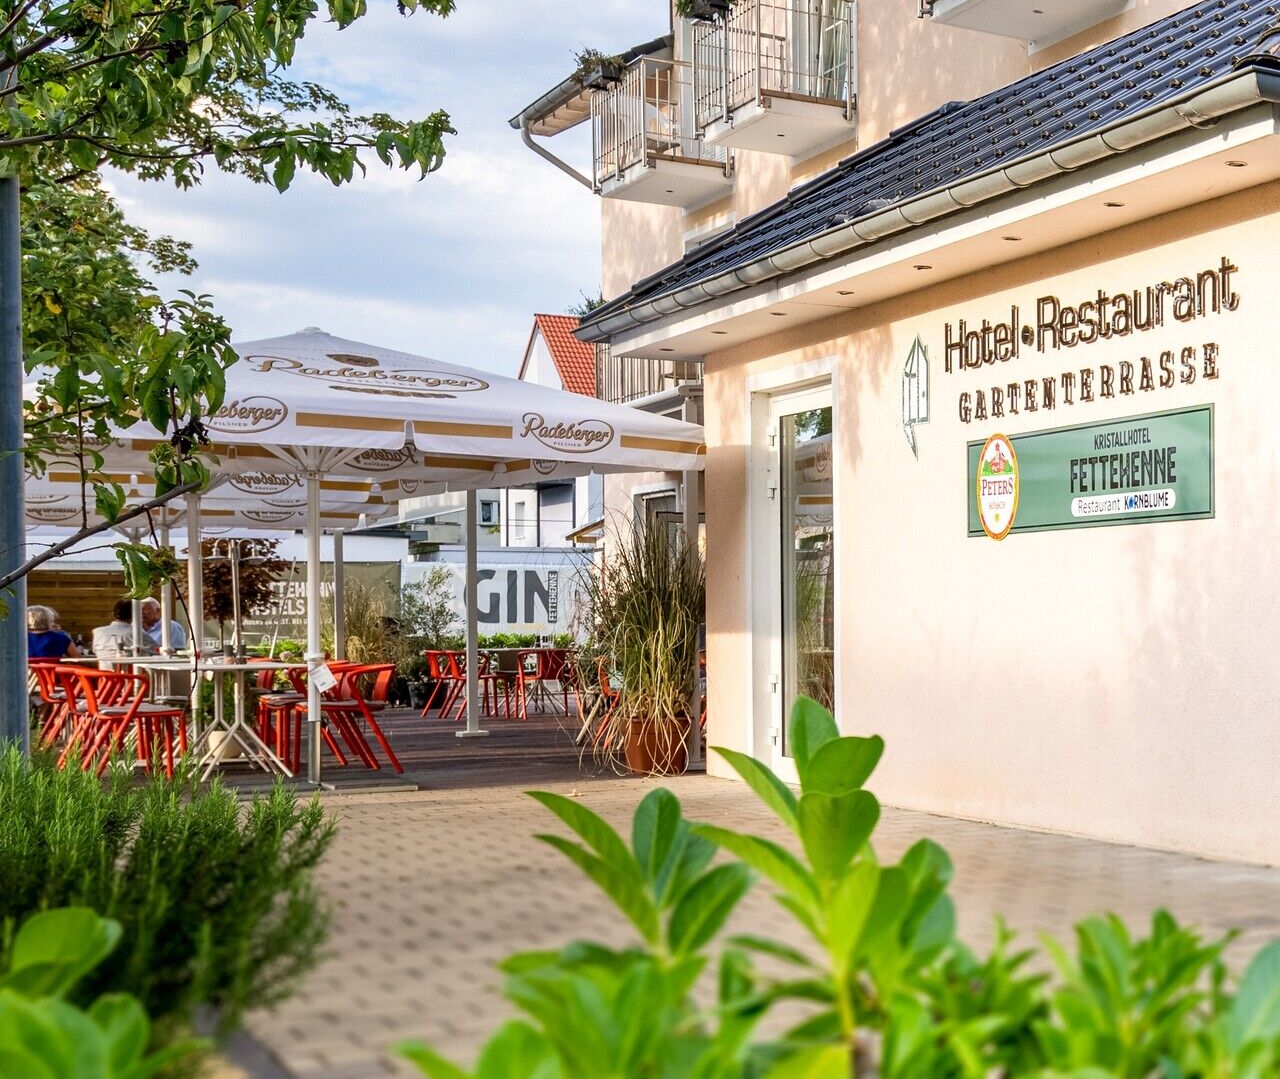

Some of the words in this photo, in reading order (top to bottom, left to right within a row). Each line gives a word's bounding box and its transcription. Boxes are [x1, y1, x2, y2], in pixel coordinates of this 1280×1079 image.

[944, 304, 1019, 374] Hotel
[1036, 256, 1241, 353] Restaurant
[959, 342, 1220, 424] GARTENTERRASSE
[520, 412, 611, 447] Radeberger
[1094, 427, 1151, 450] KRISTALLHOTEL
[982, 478, 1014, 496] PETERS
[1070, 446, 1177, 493] FETTEHENNE
[1078, 497, 1121, 514] Restaurant
[1124, 492, 1169, 510] KRNBLUME
[464, 570, 557, 624] GIN
[549, 573, 557, 621] FETTEHENNE
